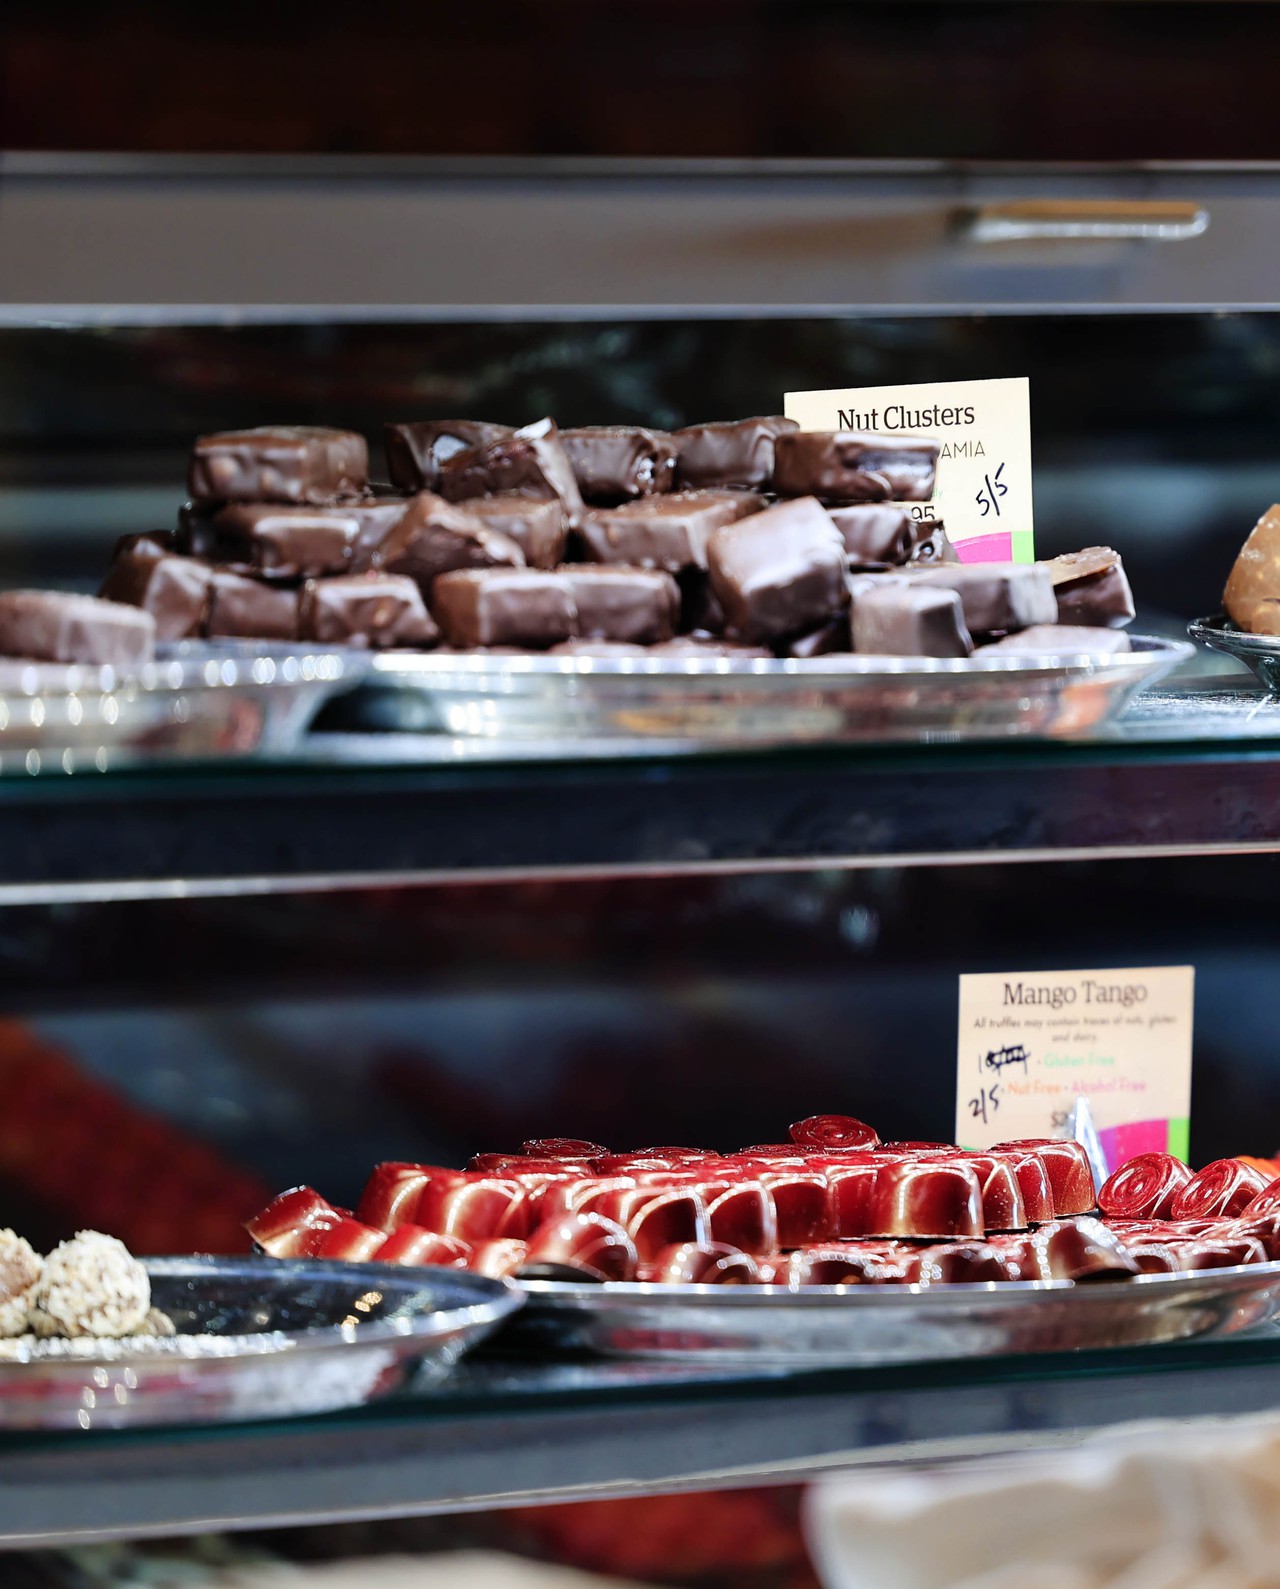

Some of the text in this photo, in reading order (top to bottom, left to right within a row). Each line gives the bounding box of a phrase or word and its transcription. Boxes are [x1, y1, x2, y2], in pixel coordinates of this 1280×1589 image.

[838, 404, 976, 431] Nut Clusters
[940, 440, 986, 459] AMIA
[975, 462, 1008, 516] 5/5
[911, 505, 936, 521] 95
[1003, 980, 1148, 1009] Mango Tango
[973, 1017, 987, 1028] All
[989, 1016, 1021, 1028] truffles
[1024, 1018, 1043, 1030] may
[1052, 1031, 1069, 1042] and
[1044, 1053, 1086, 1068] Gluten
[1087, 1051, 1116, 1066] Free
[1008, 1079, 1062, 1096] Nut Free
[1071, 1076, 1147, 1094] Alcohol Free
[1051, 1110, 1070, 1129] $2
